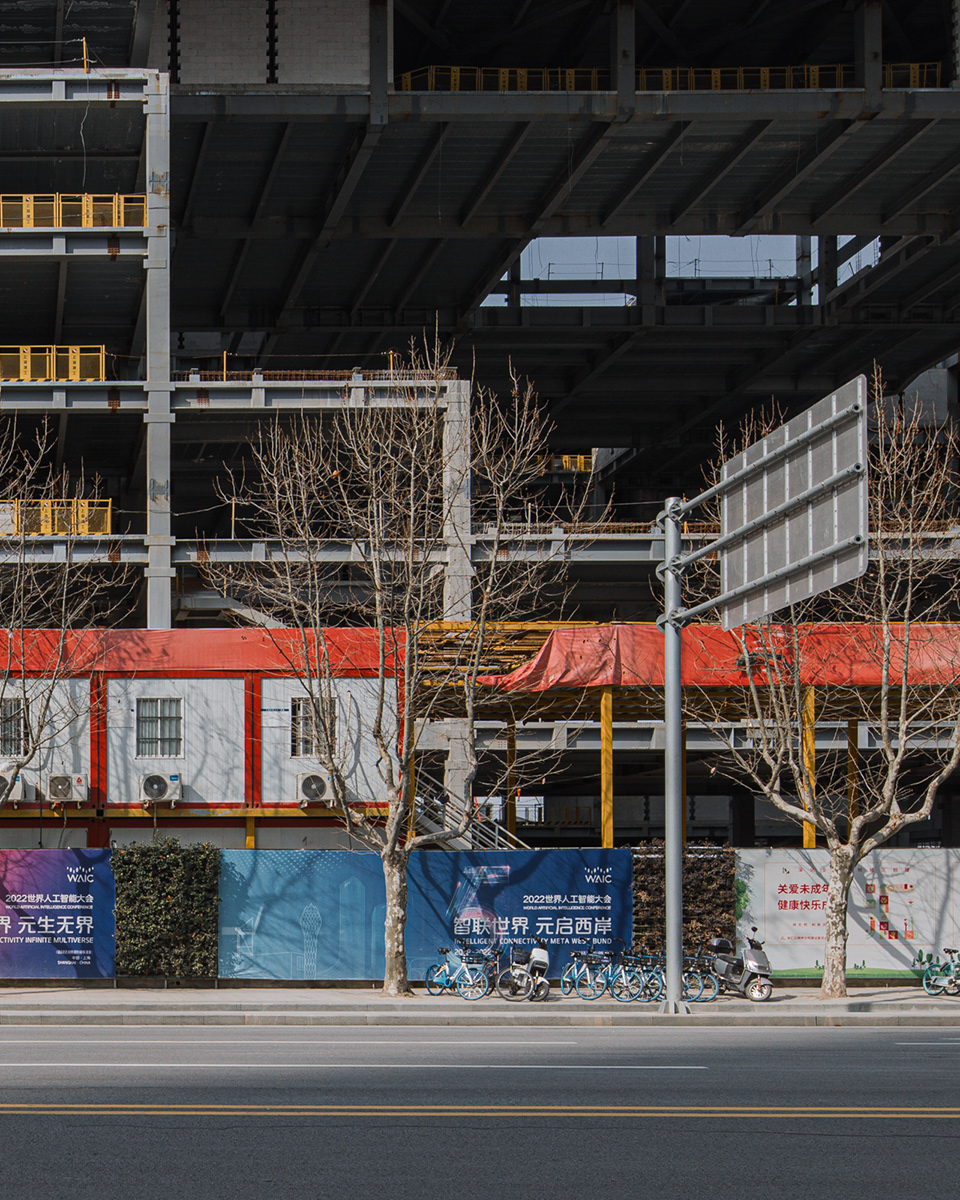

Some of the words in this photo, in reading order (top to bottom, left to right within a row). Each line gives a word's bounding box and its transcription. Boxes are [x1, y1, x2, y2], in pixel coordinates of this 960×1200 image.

[67, 874, 94, 883] WAIC
[584, 875, 612, 884] WAIC
[777, 884, 829, 894] 关爱未成年
[5, 893, 94, 903] 2022世界人工智能大会
[522, 894, 612, 904] 2022世界人工智能大会
[18, 915, 94, 934] 元生无界
[453, 916, 529, 935] 智联世界
[535, 916, 612, 935] 元启西岸
